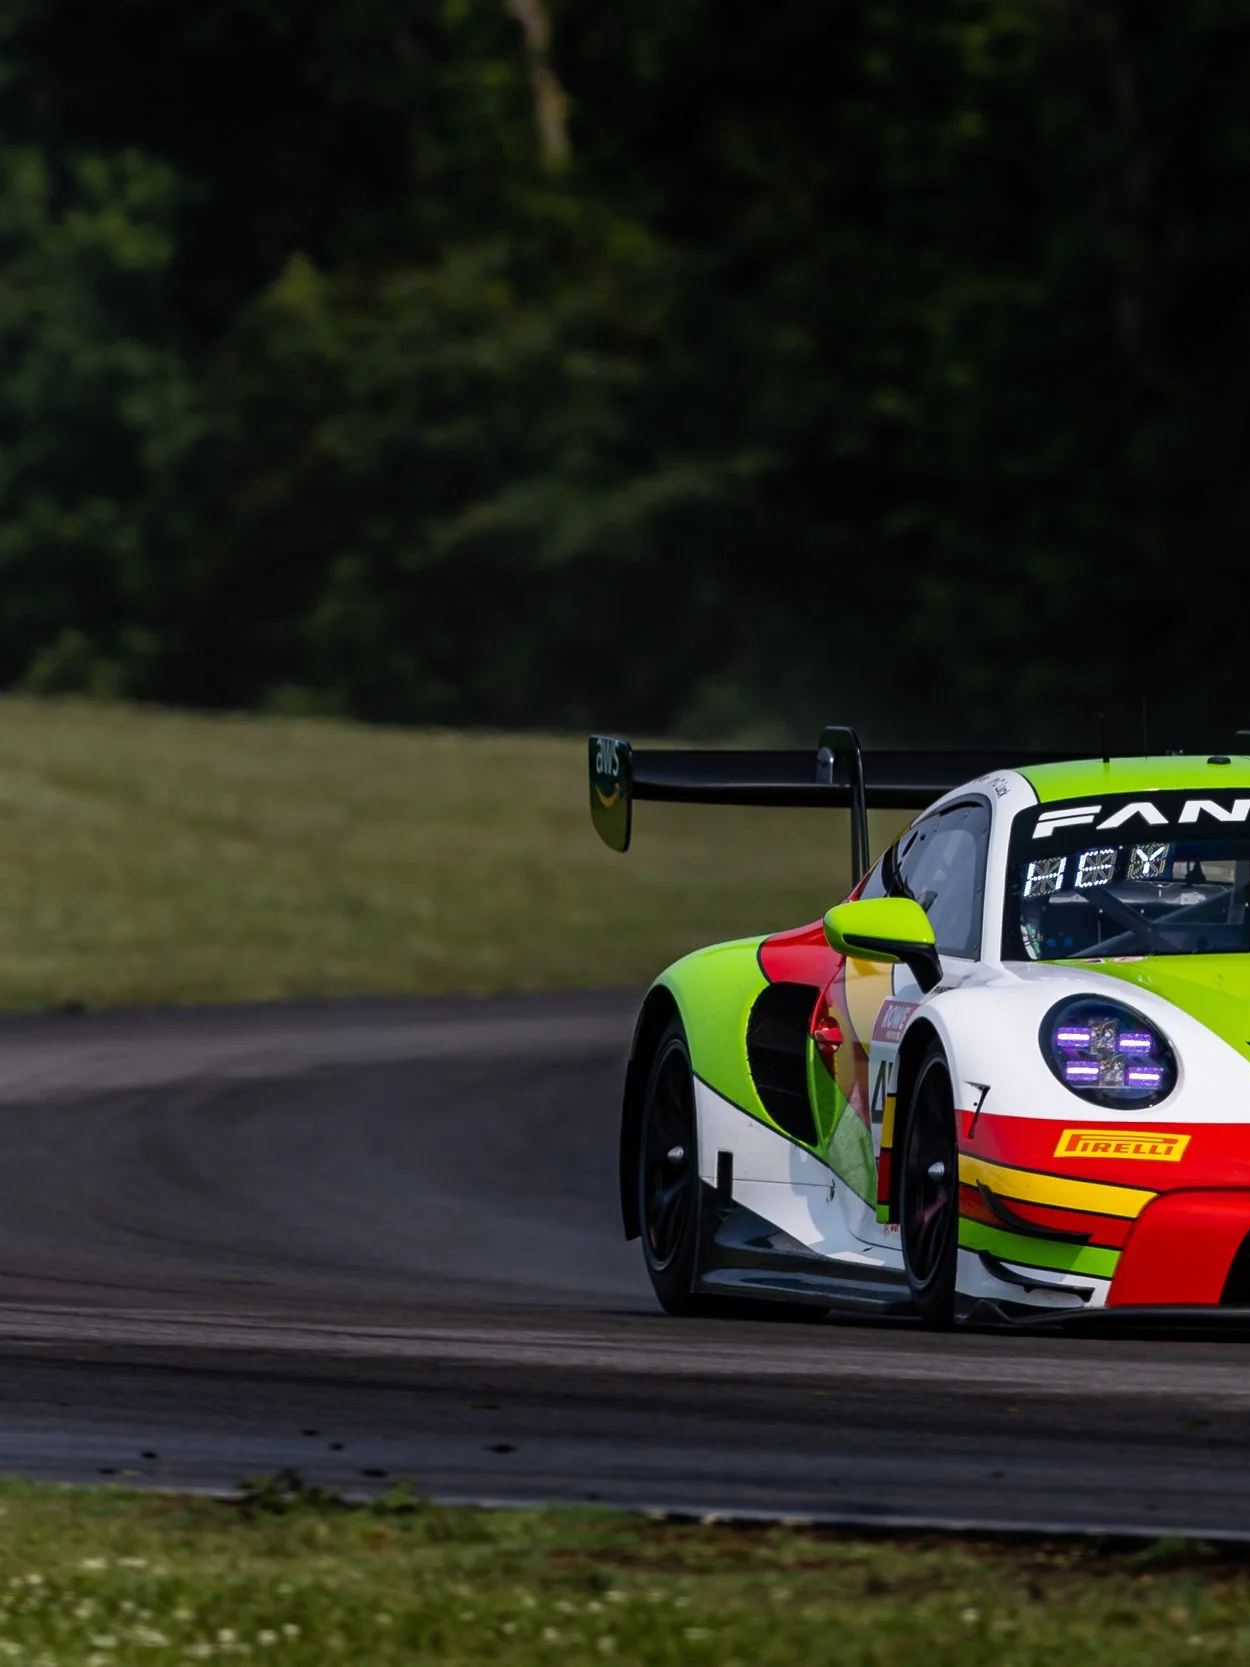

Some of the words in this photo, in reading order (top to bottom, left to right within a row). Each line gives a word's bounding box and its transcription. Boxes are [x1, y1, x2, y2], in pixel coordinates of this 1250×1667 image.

[596, 738, 620, 777] aws
[1023, 845, 1167, 898] HEY
[1064, 1133, 1179, 1156] PIRELLI
